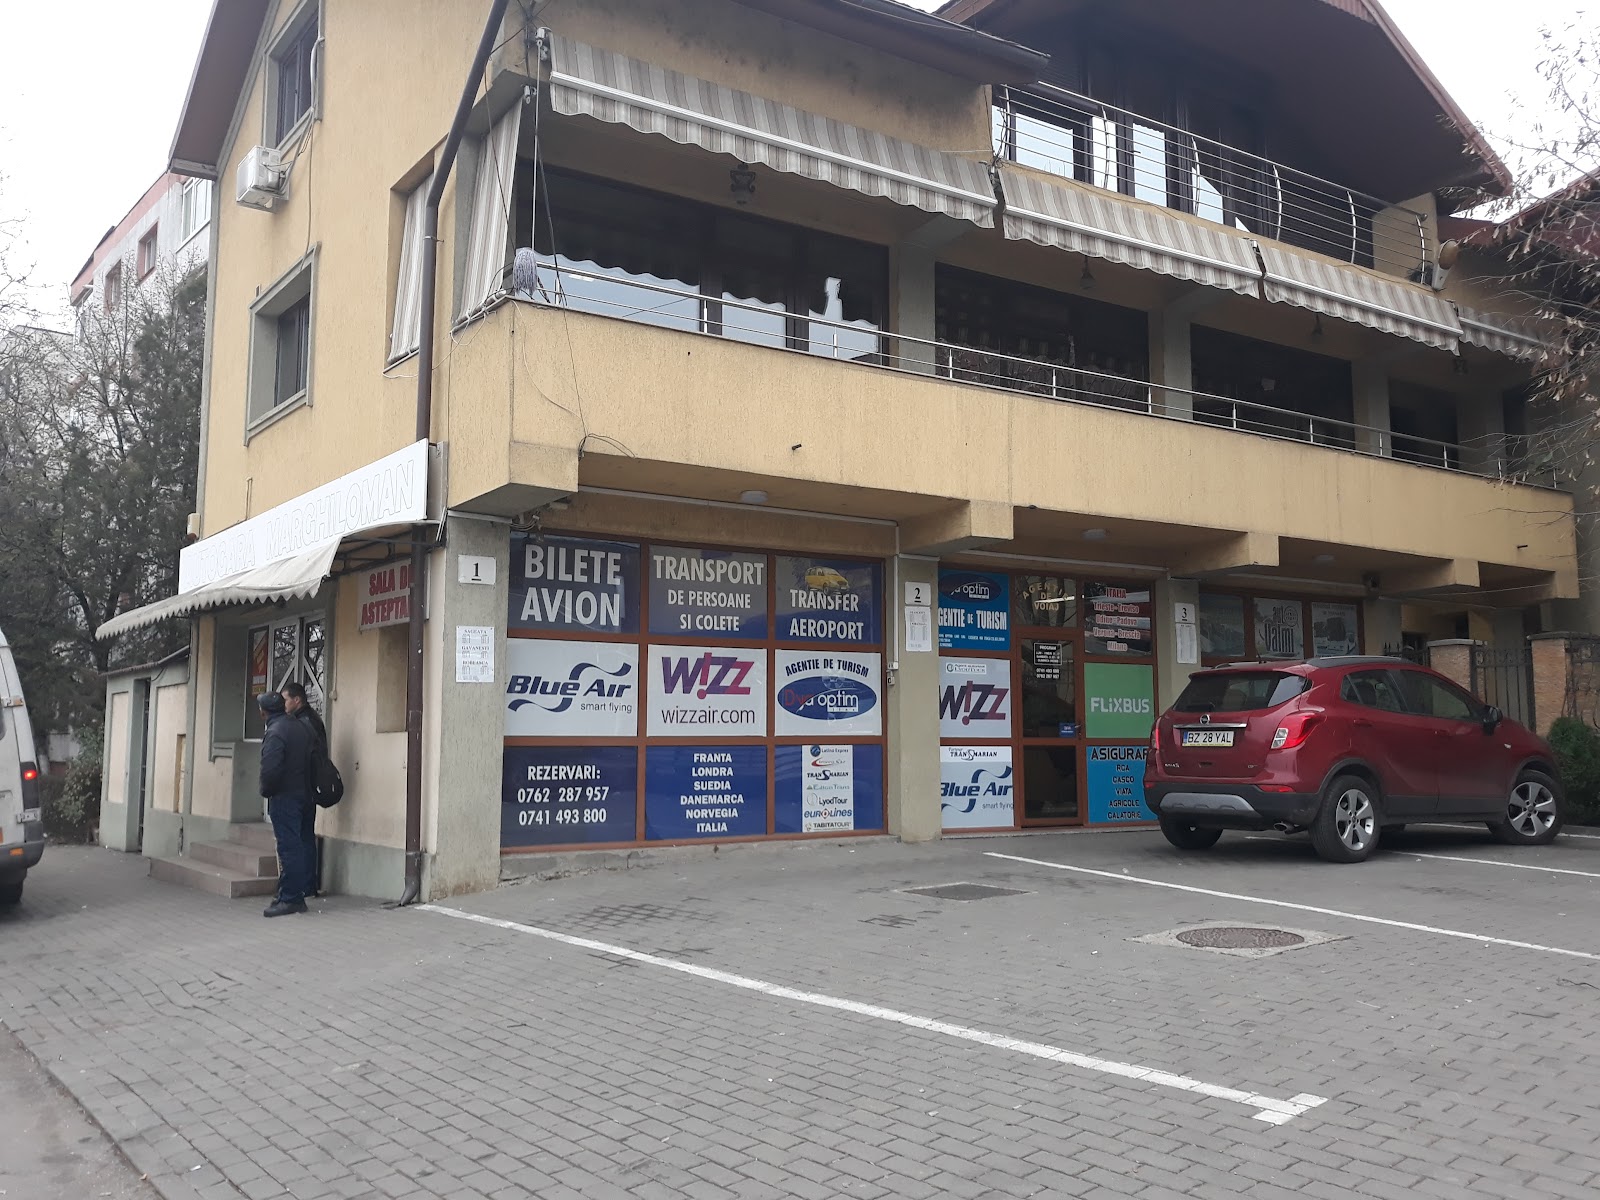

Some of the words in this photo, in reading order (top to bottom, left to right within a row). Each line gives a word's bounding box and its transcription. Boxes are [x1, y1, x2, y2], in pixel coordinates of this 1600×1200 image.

[265, 459, 415, 561] MARGHILOMAN
[473, 562, 479, 577] 1
[524, 544, 621, 586] BILETE
[653, 555, 764, 586] TRANSPORT
[369, 568, 396, 597] SALA
[914, 587, 921, 600] 2
[962, 583, 990, 598] optim
[1041, 592, 1052, 600] DE
[1105, 587, 1127, 599] ITALIA
[520, 586, 620, 627] AVION
[667, 589, 685, 606] DE
[688, 590, 751, 609] PERSOANE
[790, 589, 859, 612] TRANSFER
[1034, 602, 1060, 611] VOIAJ
[967, 613, 974, 624] DE
[976, 610, 1007, 630] TURISM
[1181, 607, 1188, 619] 3
[680, 614, 692, 630] SI
[695, 614, 740, 632] COLETE
[789, 617, 864, 640] AEROPORT
[785, 658, 820, 676] AGENTIE
[823, 658, 834, 669] DE
[837, 659, 869, 678] TURISM
[506, 675, 580, 696] Blue
[583, 679, 631, 698] Air
[580, 702, 606, 711] smart
[608, 702, 633, 714] flying
[817, 691, 859, 711] optim
[662, 706, 755, 724] wizzair.com
[1188, 733, 1200, 743] BZ
[1202, 733, 1213, 743] 28
[1215, 733, 1231, 743] YAL
[693, 753, 732, 763] FRANTA
[527, 765, 601, 781] REZERVARI:
[692, 767, 733, 777] LONDRA
[1116, 764, 1130, 772] RCA
[693, 781, 731, 791] SUEDIA
[1112, 776, 1135, 784] CASCO
[517, 788, 550, 803] 0762
[558, 787, 582, 802] 287
[585, 786, 609, 801] 957
[983, 782, 1013, 796] Air
[1115, 788, 1132, 796] VIATA
[680, 794, 744, 805] DANEMARCA
[1109, 800, 1140, 808] AGRICOLE
[518, 810, 550, 825] 0741
[555, 810, 579, 824] 493
[583, 808, 607, 823] 800
[686, 808, 738, 819] NORVEGIA
[696, 823, 728, 832] ITALIA
